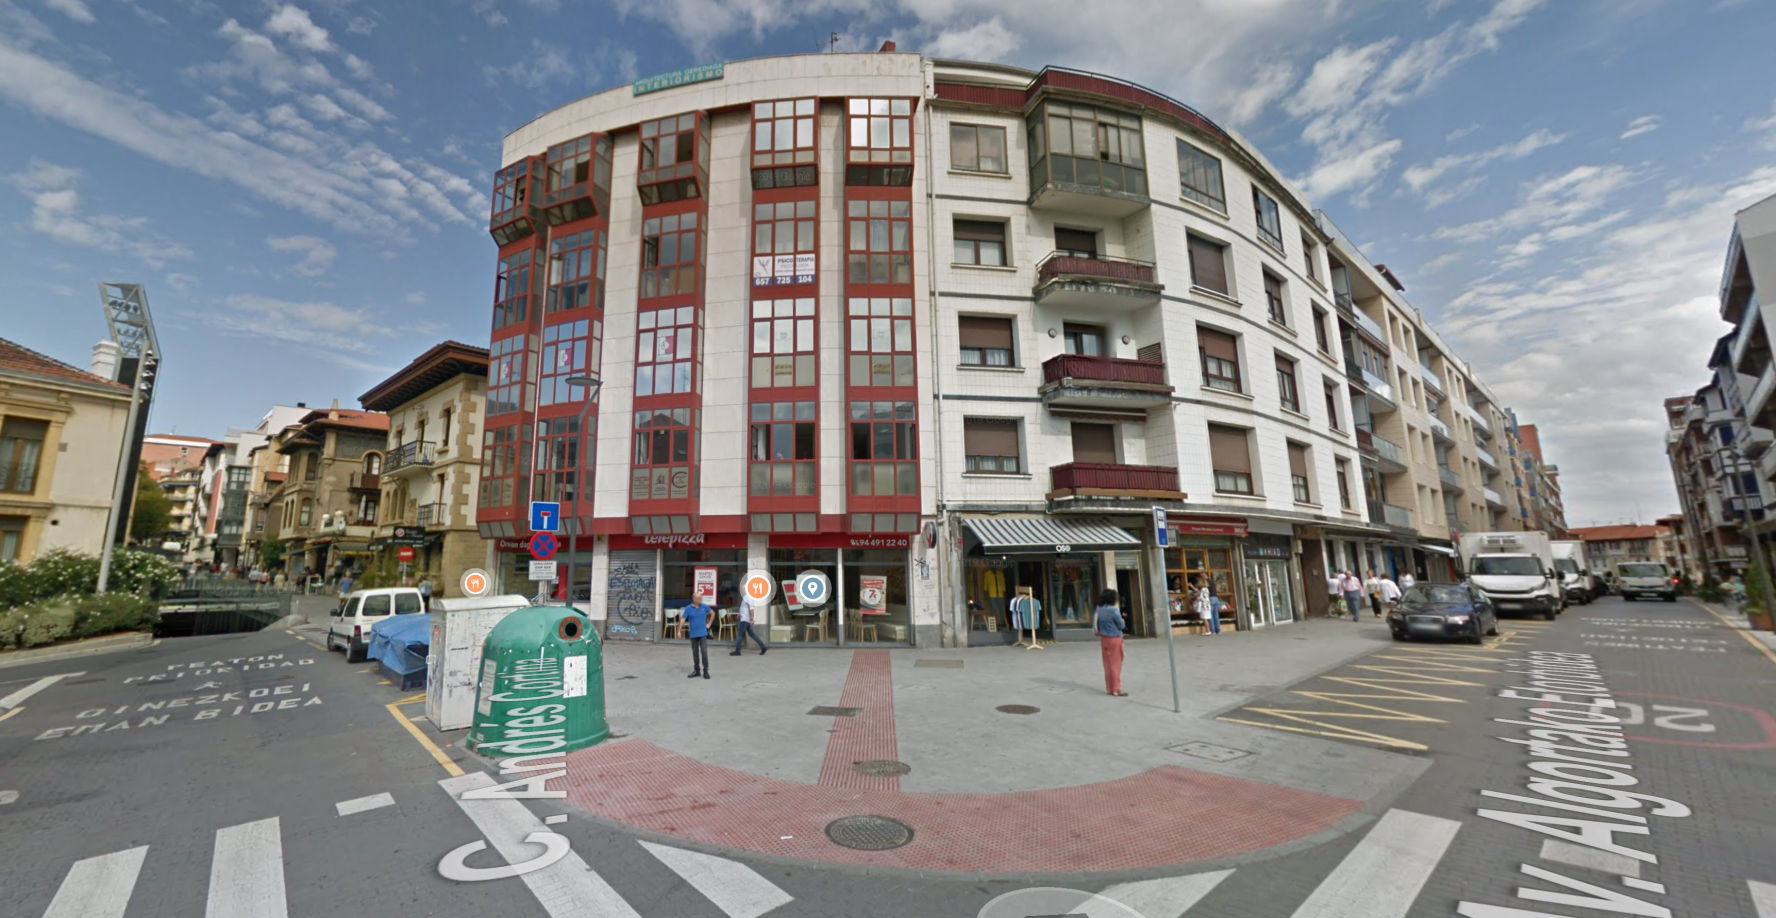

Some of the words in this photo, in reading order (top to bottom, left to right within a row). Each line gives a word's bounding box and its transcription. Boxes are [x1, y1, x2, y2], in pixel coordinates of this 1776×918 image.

[634, 69, 723, 94] INTERIORISMO
[755, 277, 770, 286] 657
[776, 276, 791, 285] 725
[798, 275, 813, 284] 104
[870, 539, 885, 547] 491
[886, 539, 897, 547] 22
[897, 538, 908, 547] 40
[32, 714, 172, 742] EMAN
[192, 695, 324, 721] BIDEA
